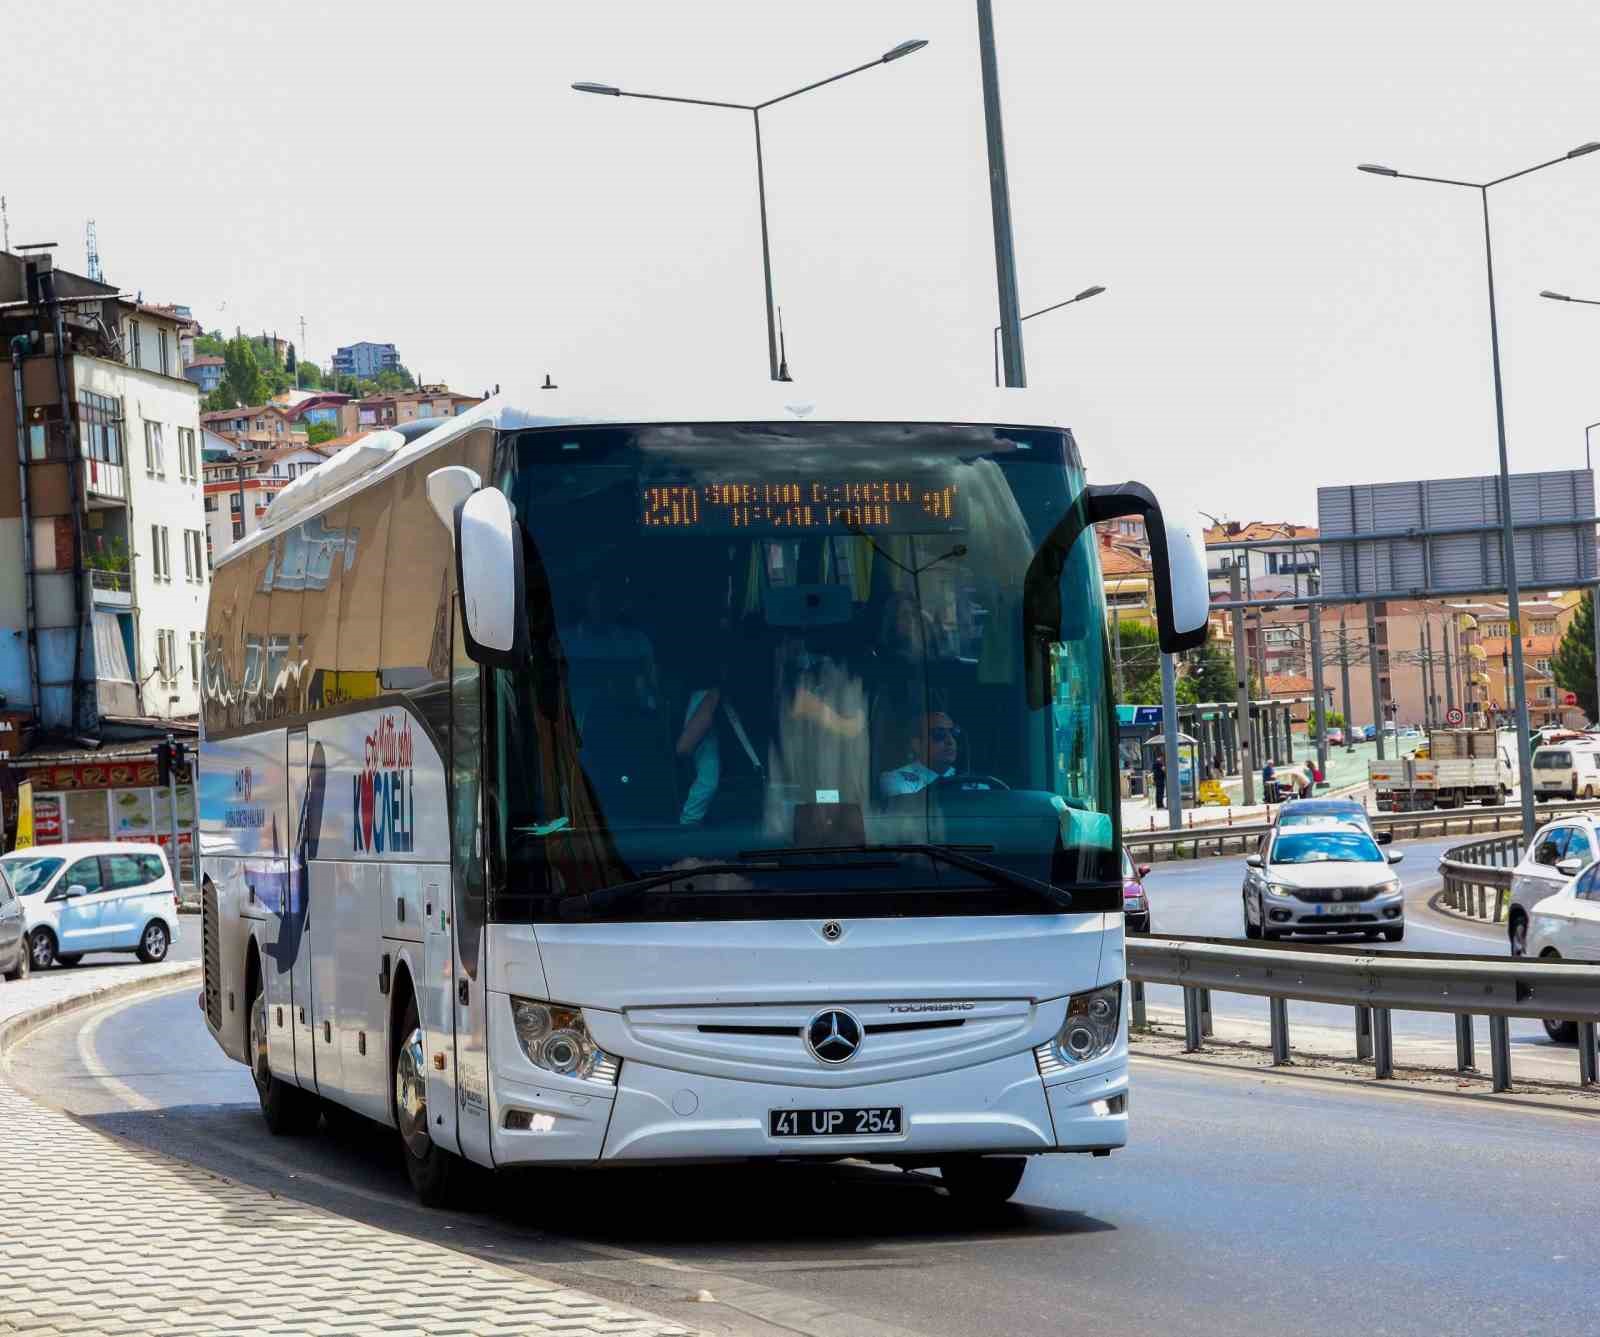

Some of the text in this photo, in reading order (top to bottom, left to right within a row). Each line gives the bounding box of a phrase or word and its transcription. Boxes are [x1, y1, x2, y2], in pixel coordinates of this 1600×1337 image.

[643, 487, 697, 526] 250
[888, 1001, 976, 1013] TOURISMO
[776, 1108, 896, 1134] 41 UP 254
